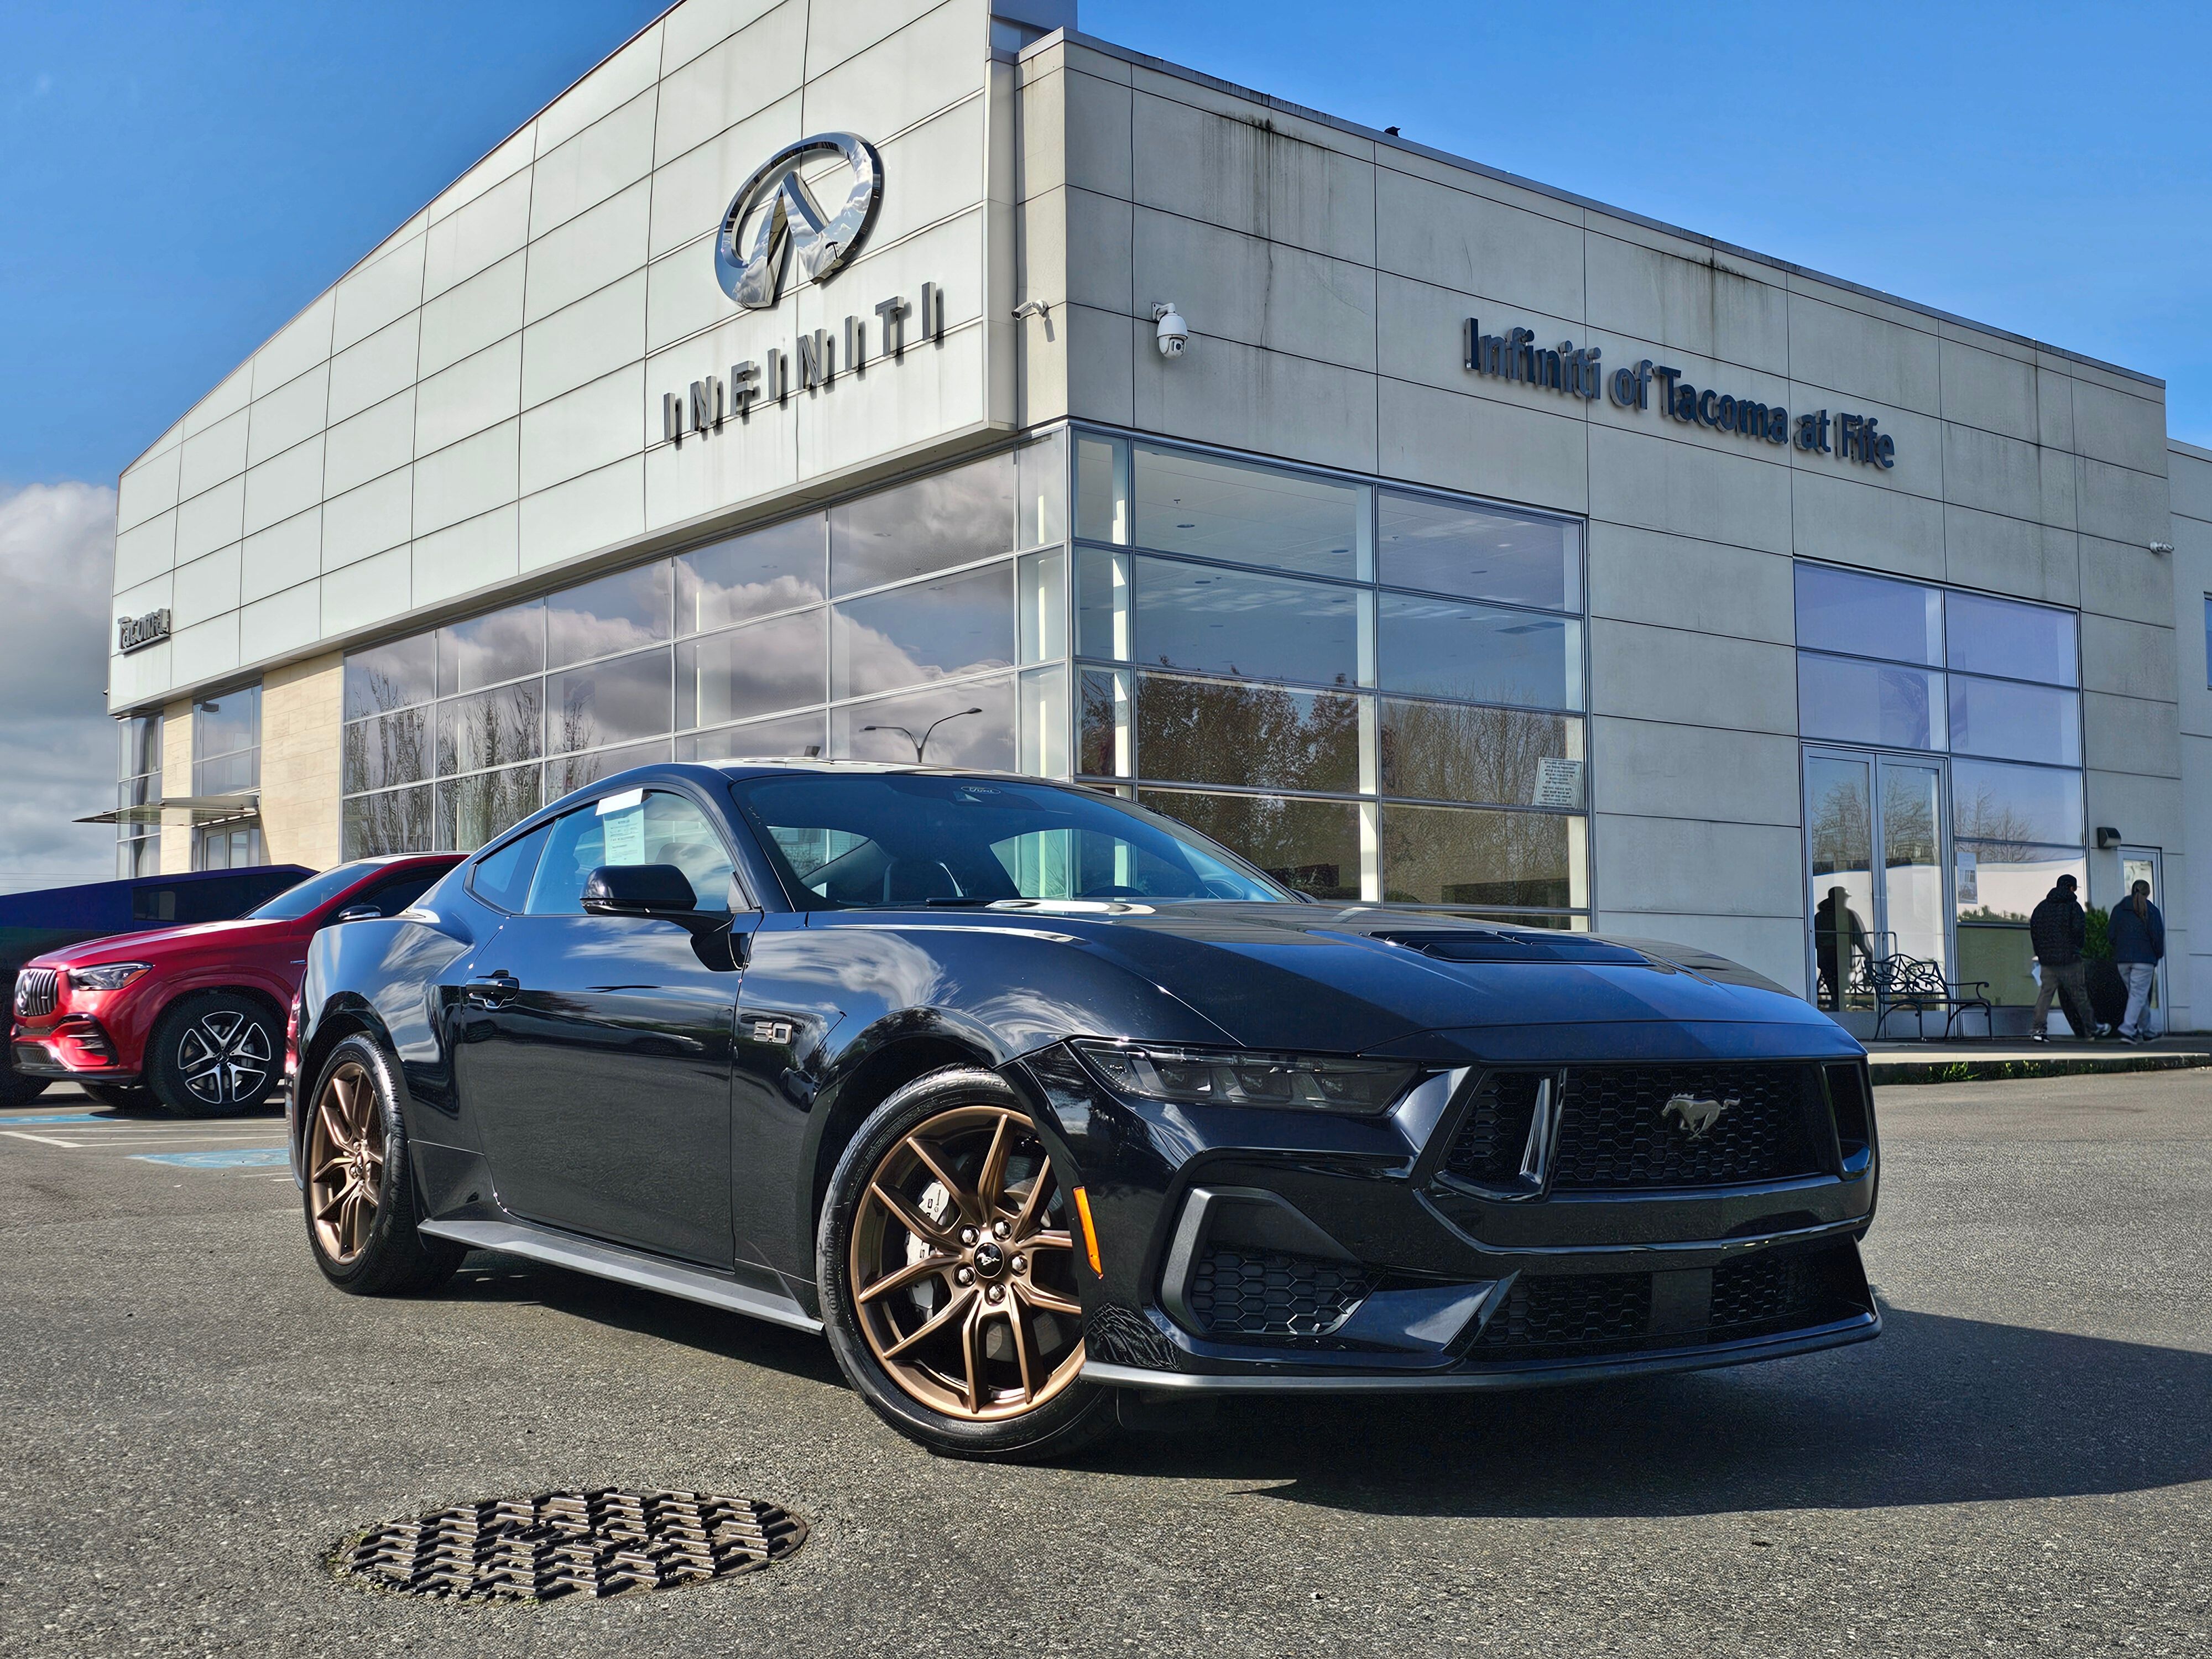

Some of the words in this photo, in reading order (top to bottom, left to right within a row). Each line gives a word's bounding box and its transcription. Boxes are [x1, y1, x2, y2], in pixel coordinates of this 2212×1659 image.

[664, 281, 937, 442] INFINITI
[1464, 317, 1601, 400] Infiniti
[1610, 359, 1653, 411] of
[1654, 365, 1789, 445] Tacoma
[1795, 409, 1832, 453] at
[1835, 412, 1895, 469] Fife
[117, 608, 170, 650] Tacoma
